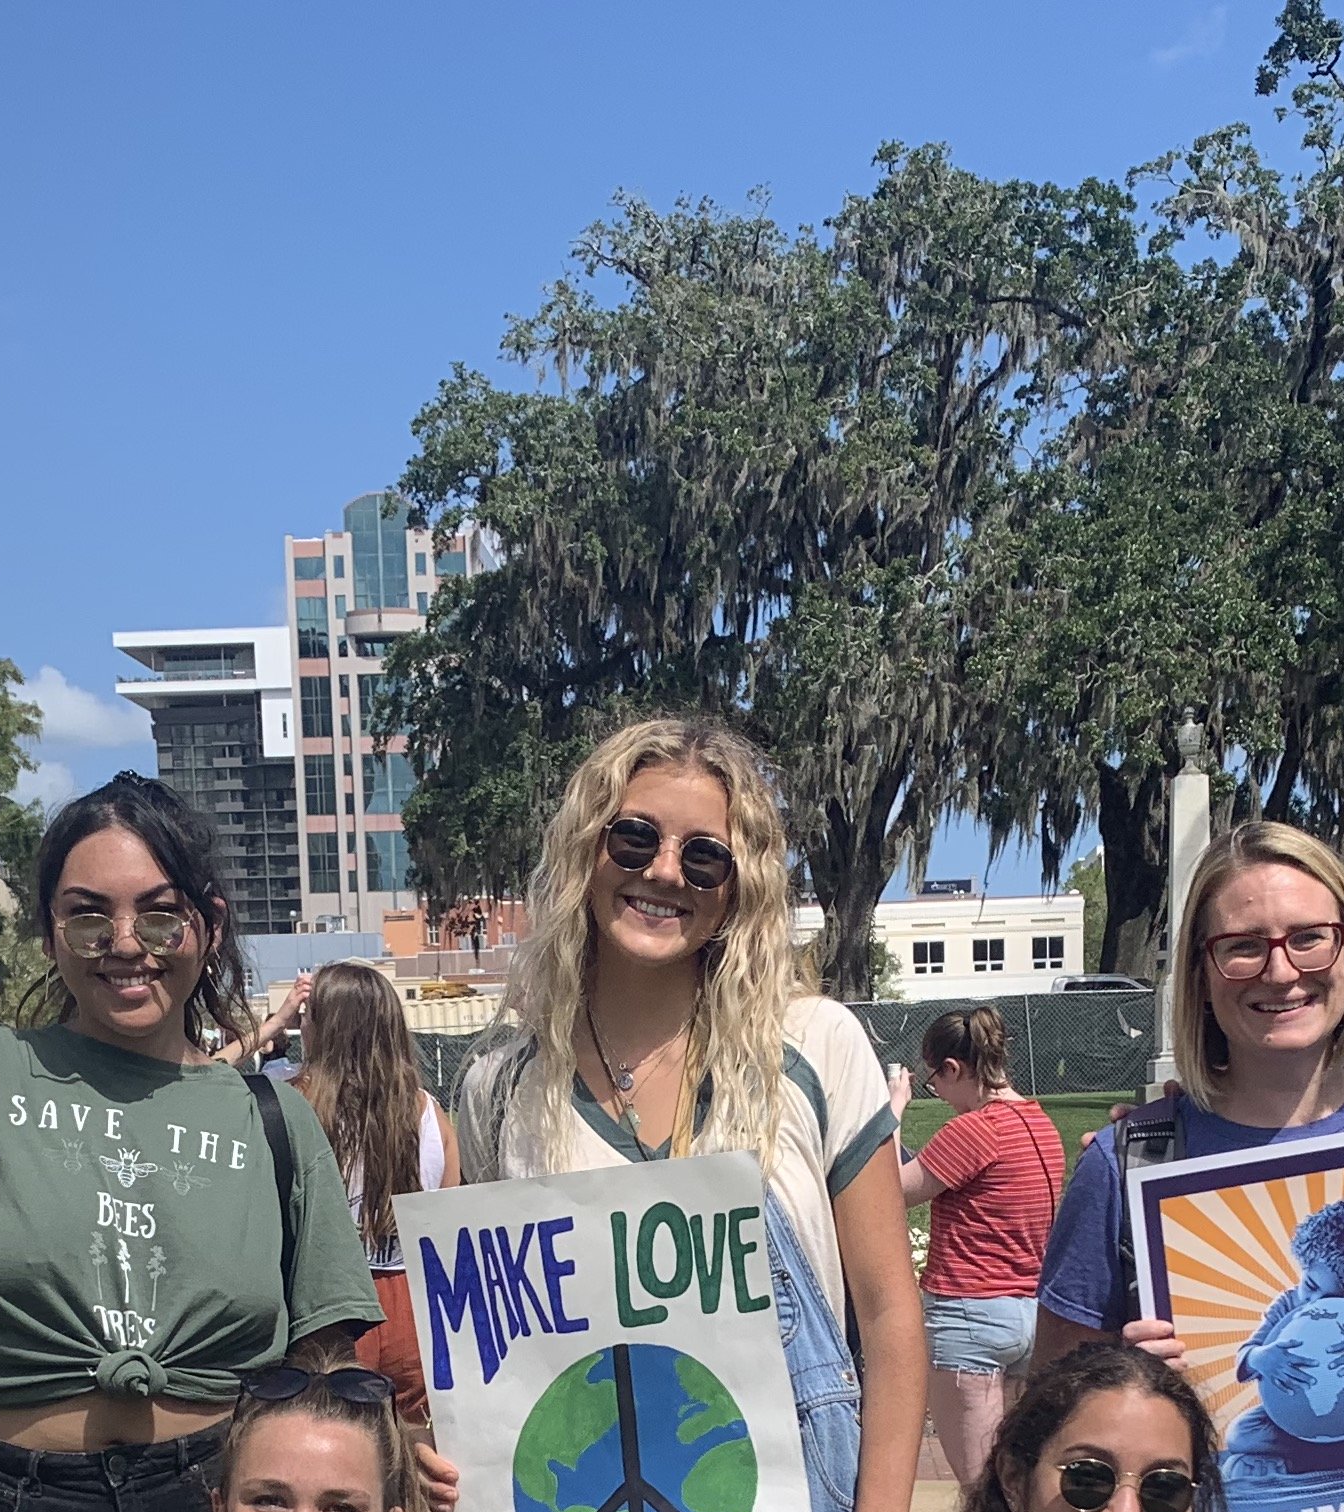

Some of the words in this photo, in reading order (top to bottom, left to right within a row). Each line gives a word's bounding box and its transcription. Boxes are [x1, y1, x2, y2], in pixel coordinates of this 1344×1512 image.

[9, 1094, 124, 1140] SAVE
[167, 1124, 248, 1170] THE
[96, 1191, 156, 1239] BEES
[418, 1216, 589, 1390] MAKE
[611, 1201, 771, 1328] LOVE
